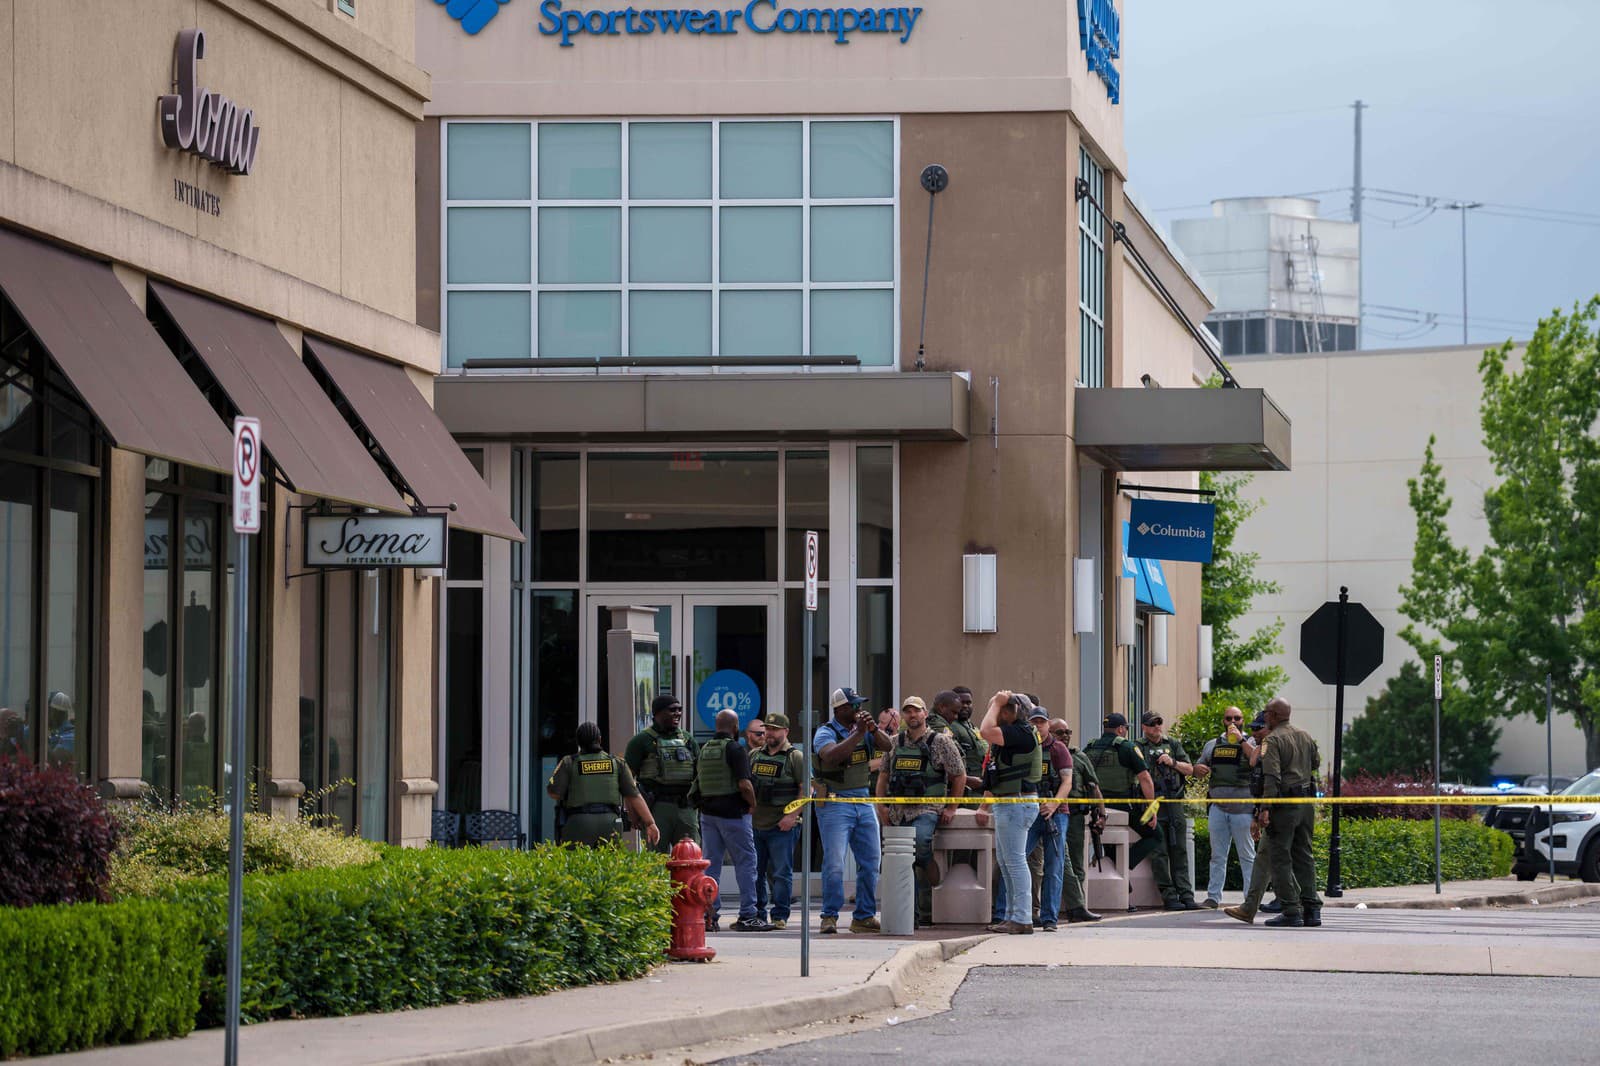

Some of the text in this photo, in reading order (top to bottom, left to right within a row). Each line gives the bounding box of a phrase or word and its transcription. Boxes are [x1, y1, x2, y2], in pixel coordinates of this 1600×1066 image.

[538, 0, 922, 46] Sportswear Company
[160, 28, 260, 176] Soma
[173, 178, 221, 217] INTIMATES
[320, 517, 431, 554] Soma
[1150, 523, 1206, 538] Columbia
[583, 762, 610, 772] SHERIFF
